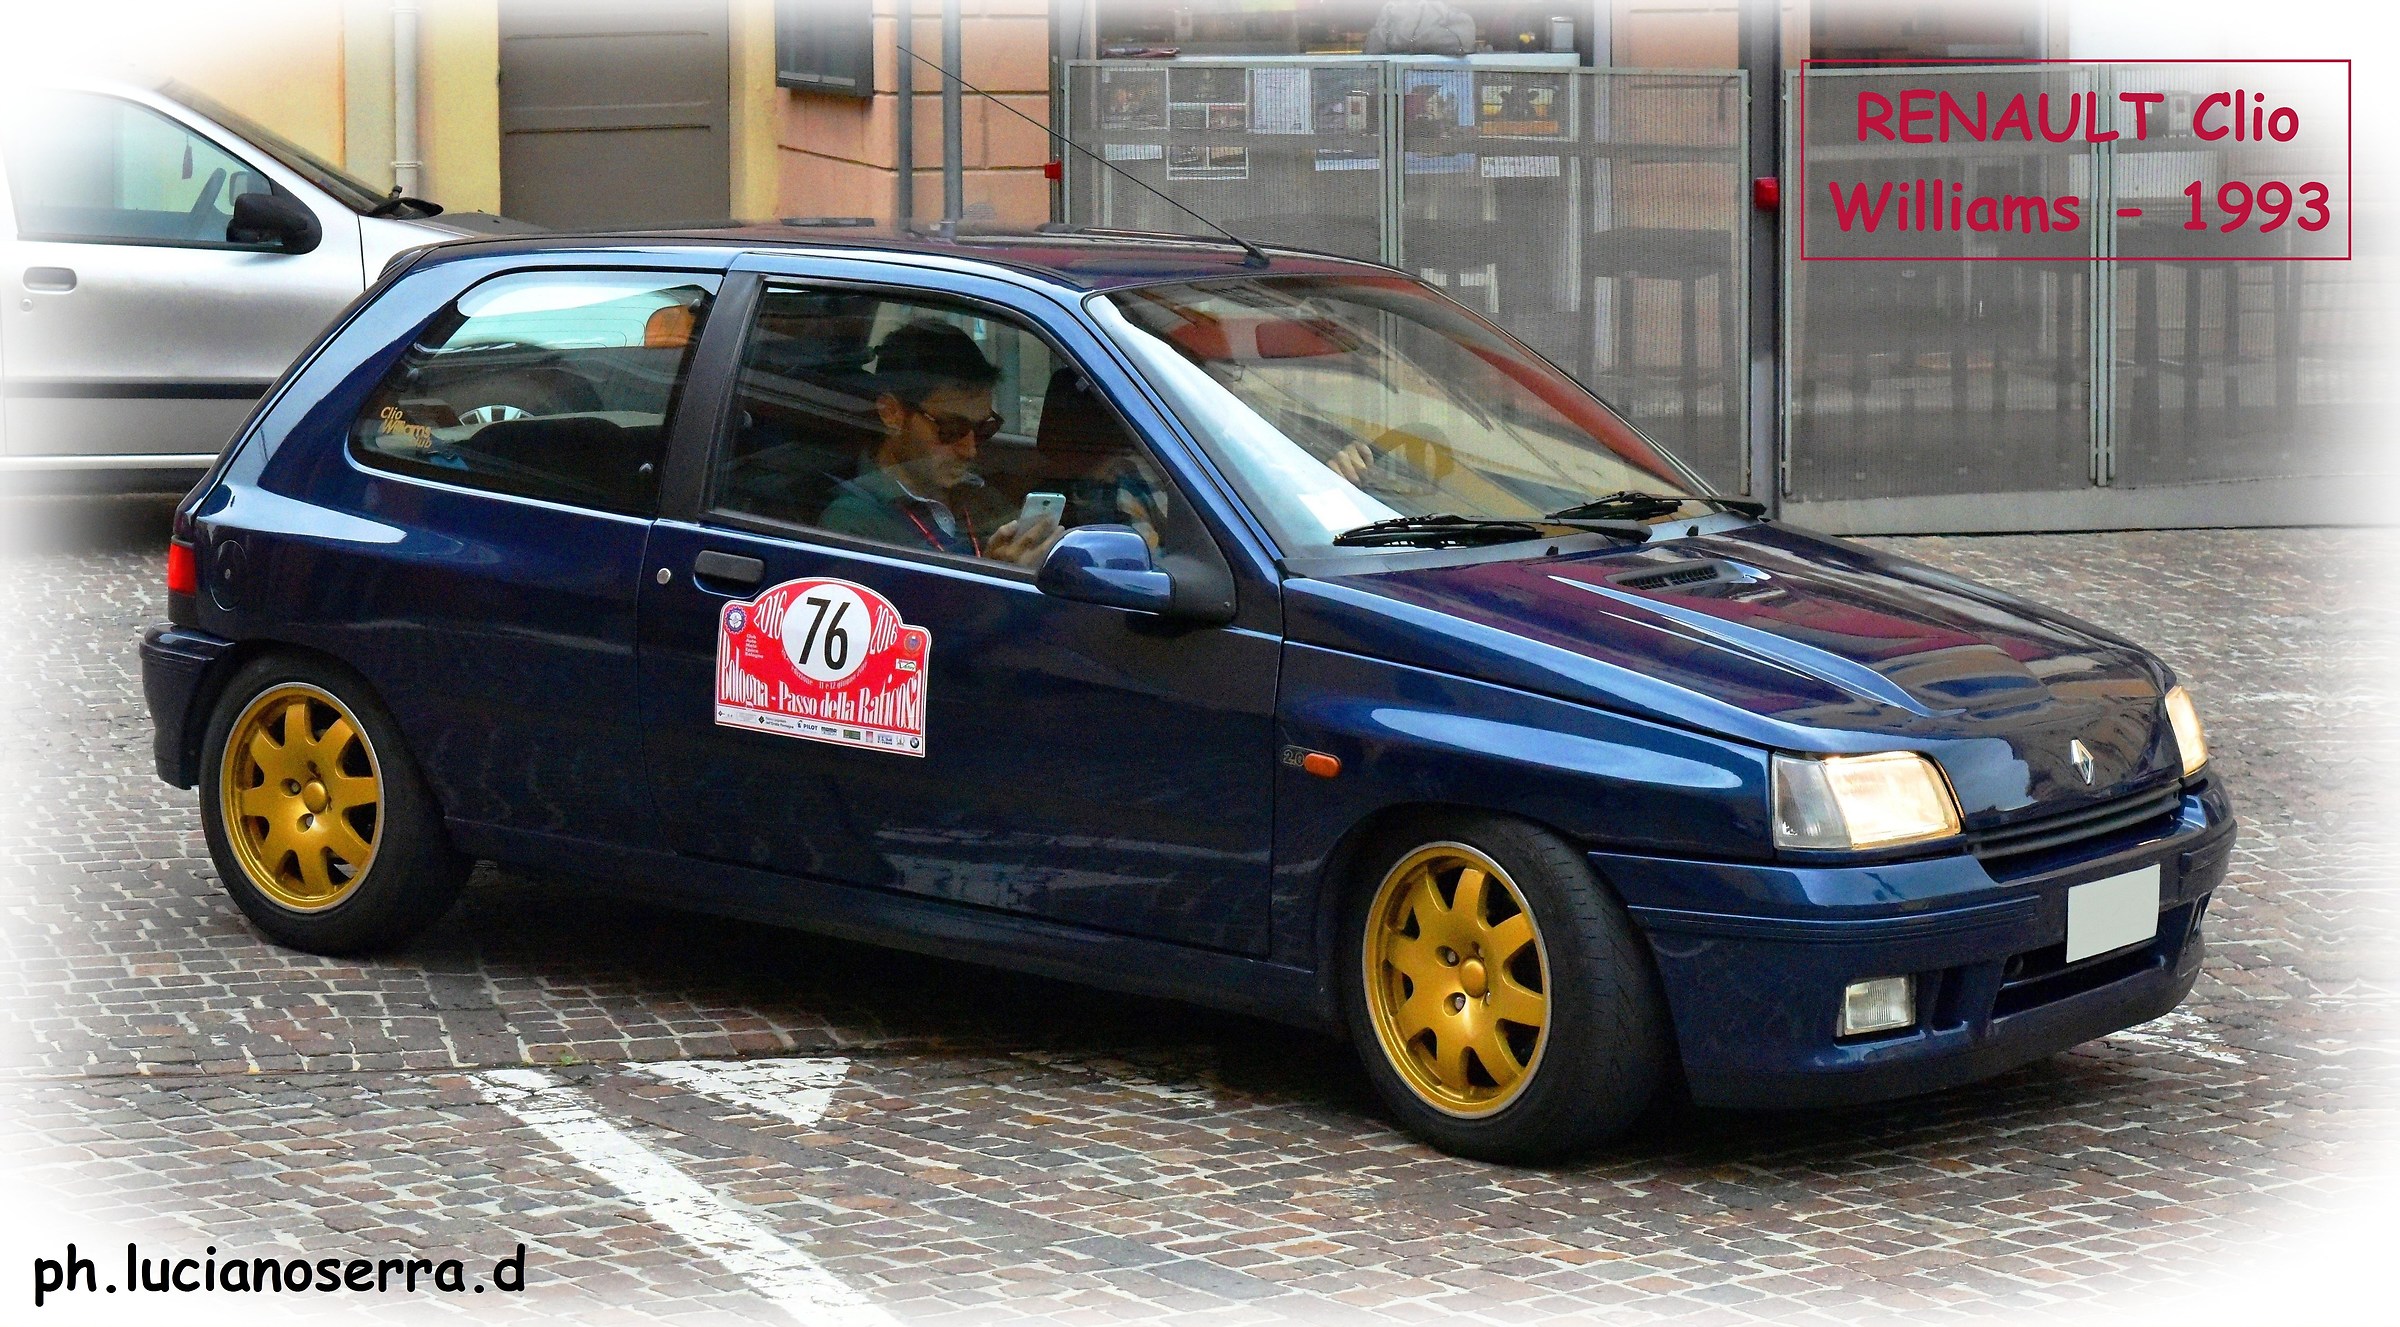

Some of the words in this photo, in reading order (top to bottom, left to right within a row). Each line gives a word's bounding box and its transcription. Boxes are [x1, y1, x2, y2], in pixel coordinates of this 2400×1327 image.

[380, 406, 403, 420] Clio
[753, 590, 788, 640] 2016
[798, 596, 851, 671] 76
[868, 604, 898, 655] 2016
[720, 631, 769, 710] Bologna
[778, 685, 817, 716] Passo
[820, 691, 854, 721] della
[857, 669, 922, 731] Raticosa
[803, 723, 818, 731] PILOT
